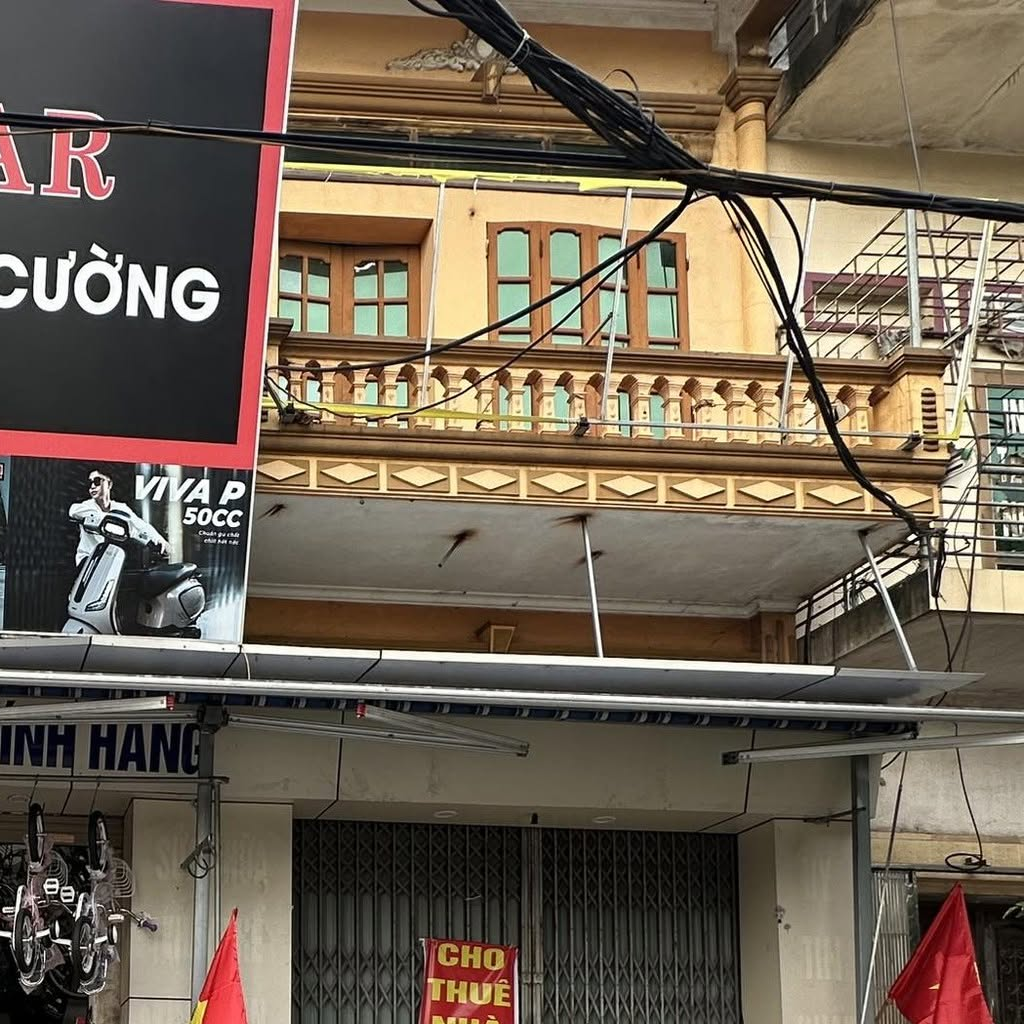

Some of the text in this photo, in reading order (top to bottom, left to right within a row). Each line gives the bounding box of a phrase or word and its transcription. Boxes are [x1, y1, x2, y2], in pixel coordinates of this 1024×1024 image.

[135, 474, 247, 506] VIVA P
[182, 506, 244, 528] 50CC
[437, 942, 505, 971] CHO
[427, 978, 511, 1007] THUÊ
